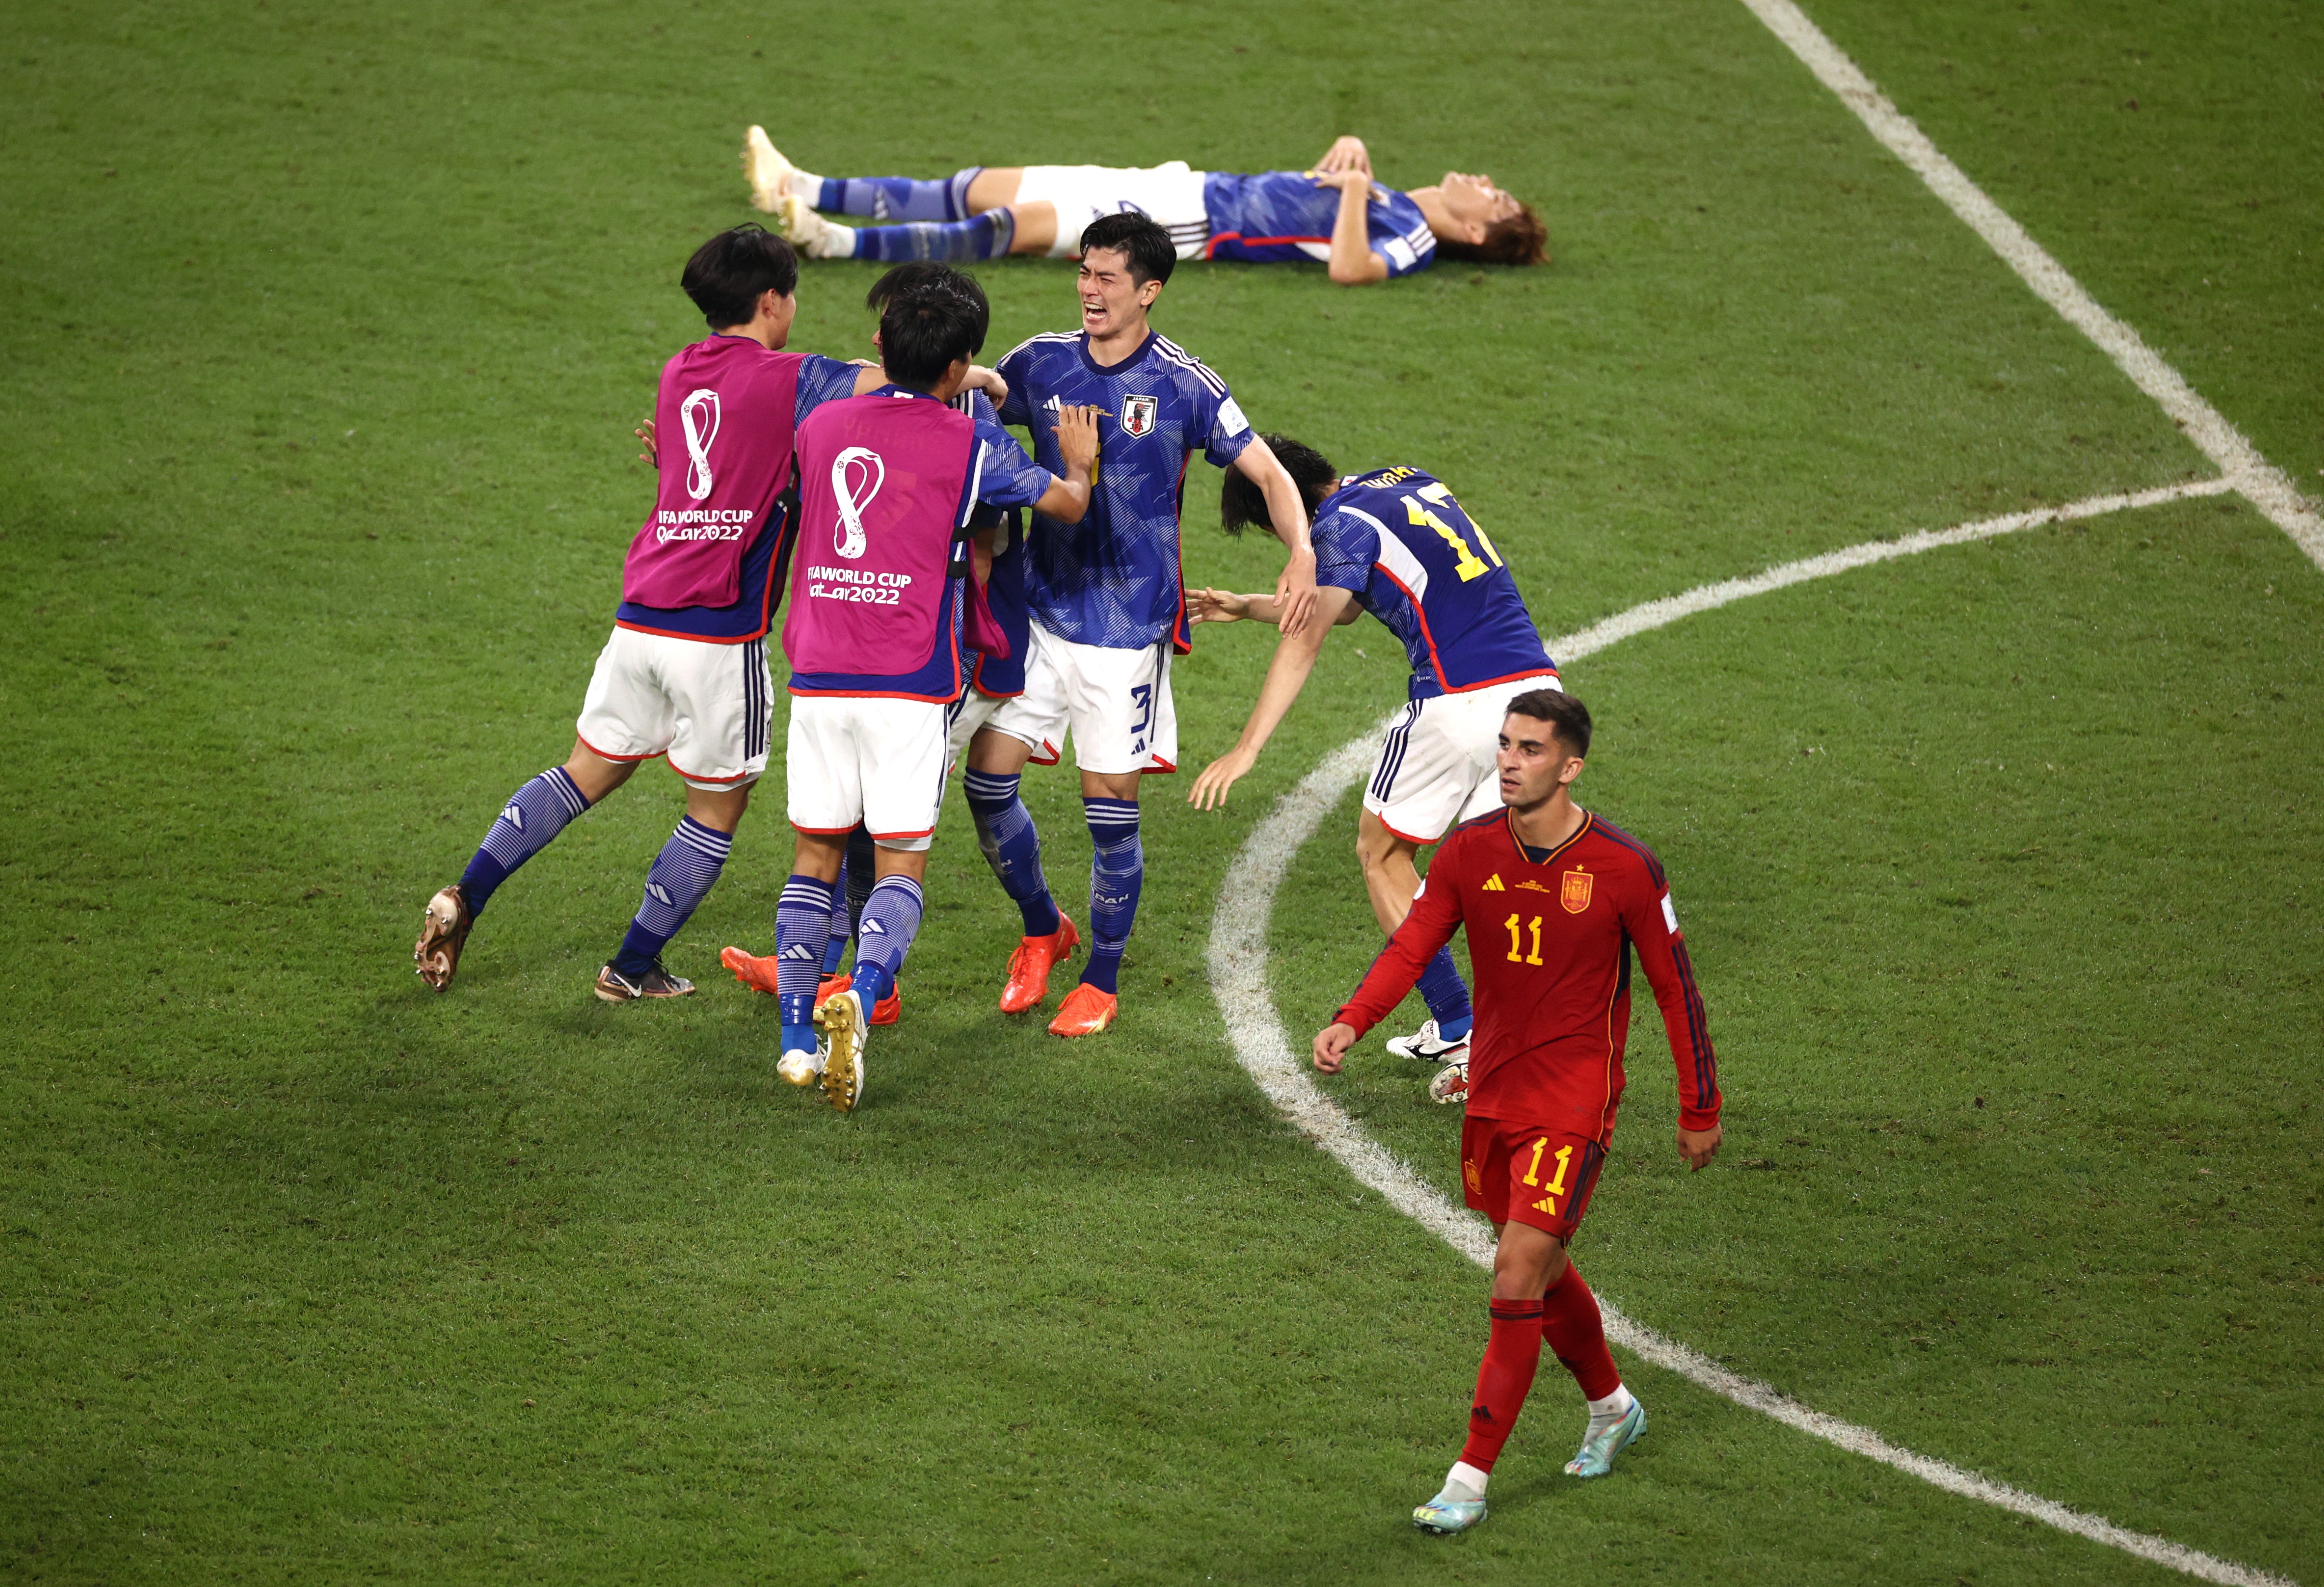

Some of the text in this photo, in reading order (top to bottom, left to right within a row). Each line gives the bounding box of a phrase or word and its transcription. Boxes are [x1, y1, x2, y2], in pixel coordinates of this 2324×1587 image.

[658, 510, 677, 524] IFA
[721, 509, 753, 523] CUP
[1400, 482, 1504, 583] 17
[809, 582, 900, 605] atar2022
[821, 566, 875, 585] WORLD
[877, 573, 912, 588] CUP
[1131, 683, 1151, 734] 3
[1504, 913, 1544, 966] 11
[1522, 1136, 1573, 1196] 11
